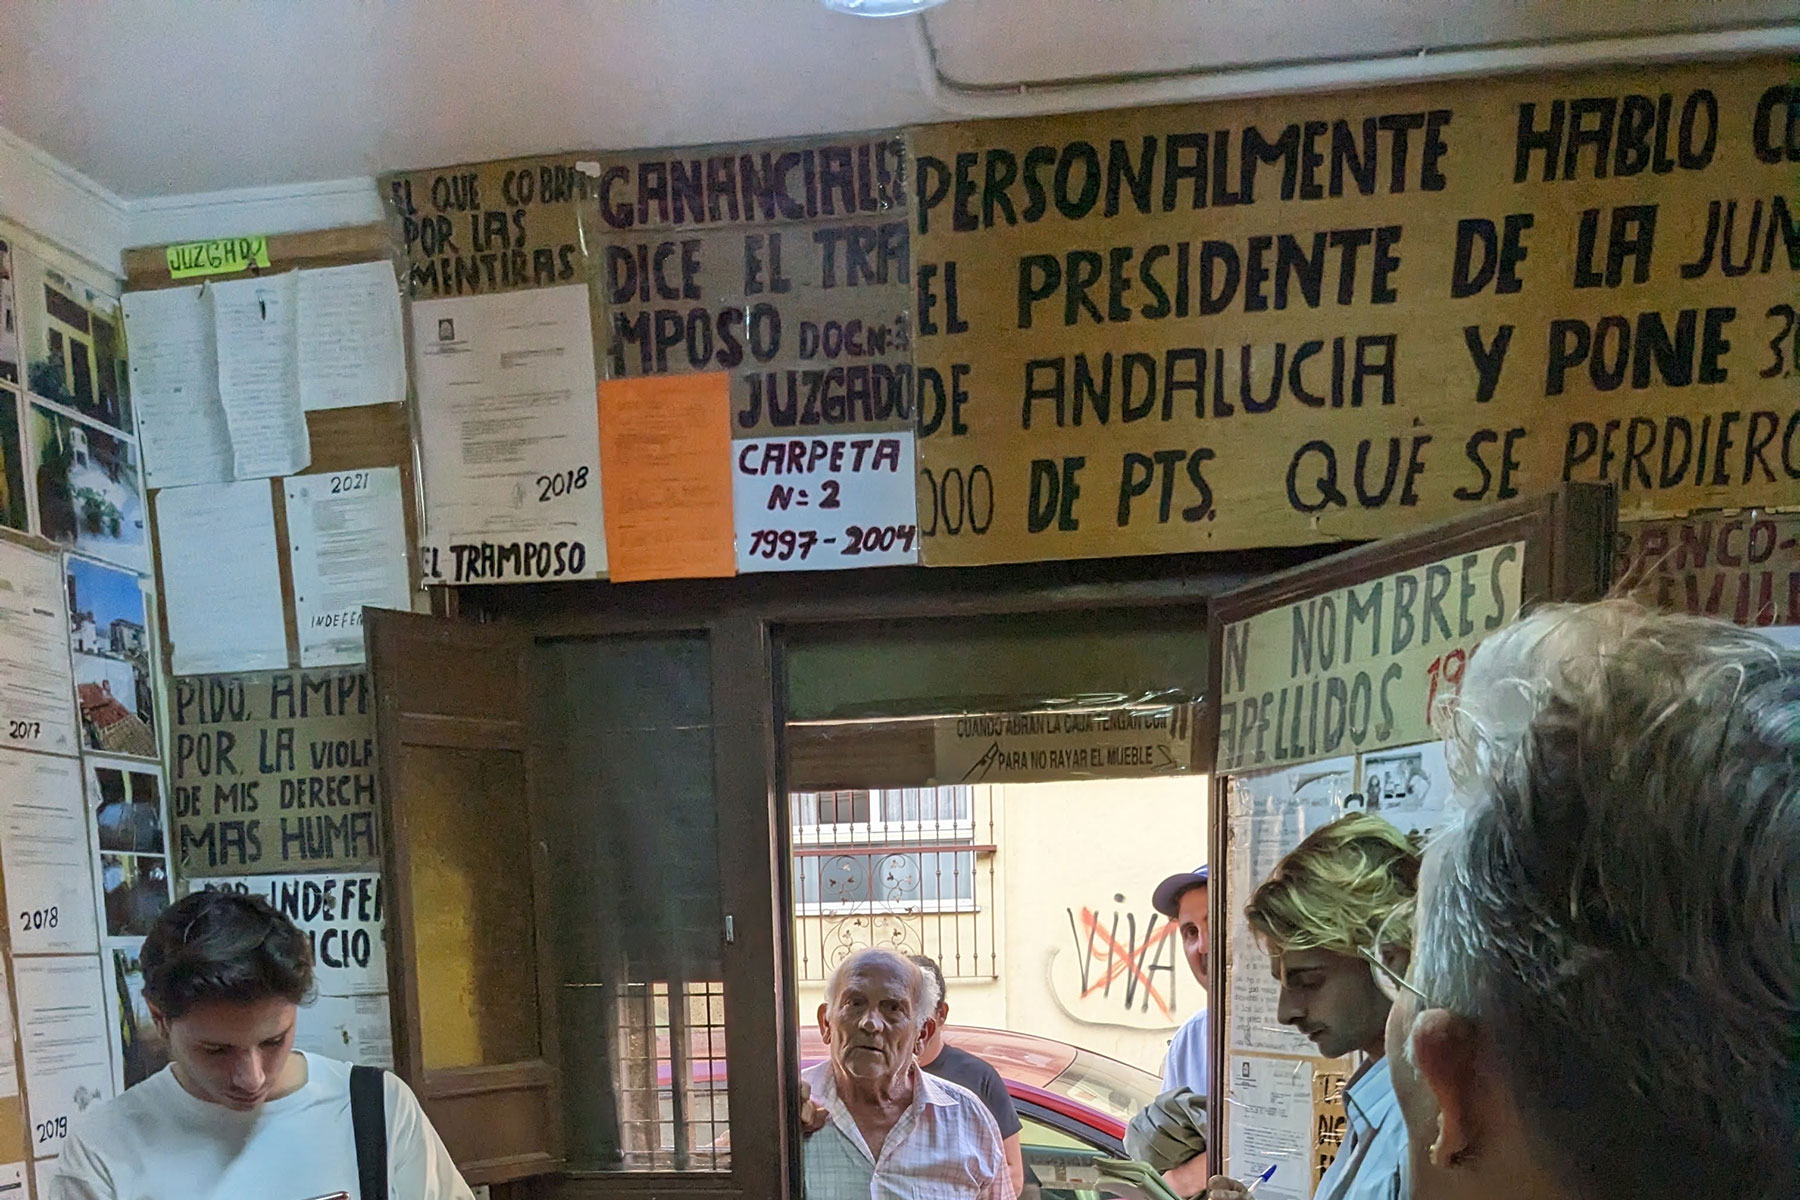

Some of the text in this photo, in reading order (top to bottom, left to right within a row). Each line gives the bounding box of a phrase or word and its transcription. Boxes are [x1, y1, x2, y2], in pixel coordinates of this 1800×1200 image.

[916, 108, 1453, 235] PERSONALMENTE
[1513, 88, 1718, 183] HABLO
[431, 173, 480, 213] QUE
[403, 208, 526, 257] POR LAS
[409, 243, 575, 297] MENTIRAS
[606, 220, 910, 304] DICE EL TRA
[917, 259, 968, 337] EL
[1017, 225, 1403, 329] PRESIDENTE
[1451, 212, 1535, 299] DE
[1573, 203, 1659, 288] LA
[917, 363, 970, 438] DE
[1022, 333, 1397, 431] ANDALUCIA
[1463, 325, 1516, 402] Y
[1544, 306, 1738, 397] PONE
[737, 362, 914, 429] JUZGADO
[739, 438, 900, 476] CARPETA
[330, 472, 369, 494] 2021
[536, 466, 589, 502] 2018
[818, 480, 841, 510] 2
[1028, 455, 1086, 533] DE
[1453, 427, 1526, 502] SE
[450, 542, 586, 582] TRAMPOSO
[1290, 545, 1517, 679] NOMBRES
[9, 720, 41, 739] 2017
[956, 718, 1001, 738] CUANDO
[1005, 714, 1043, 736] ABRAN
[1047, 713, 1061, 733] LA
[1217, 661, 1403, 770] APELLIDOS
[259, 727, 295, 774] LA
[999, 745, 1153, 771] PARA NO RAYAR EL MUEBLE
[176, 785, 202, 818] DE
[214, 780, 260, 815] MIS
[180, 819, 261, 868] MAS
[21, 906, 59, 931] 2018
[37, 1115, 68, 1143] 2019
